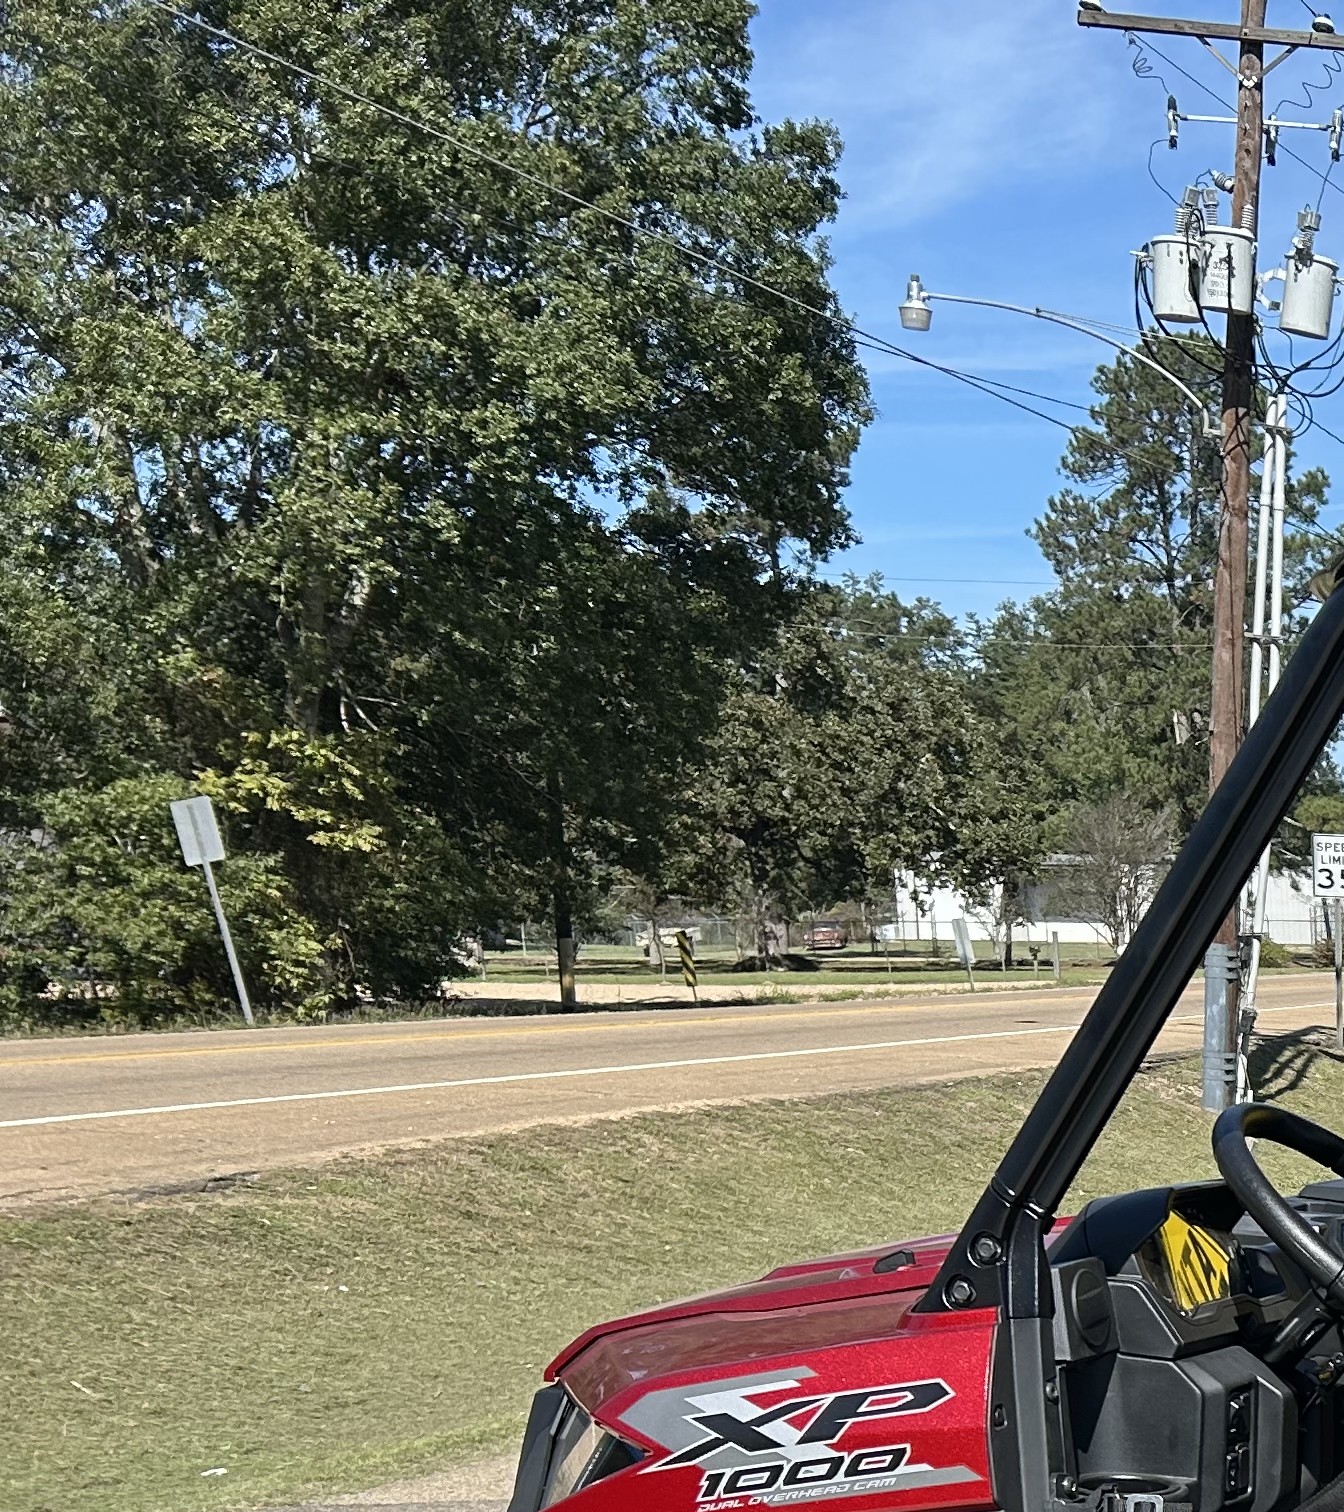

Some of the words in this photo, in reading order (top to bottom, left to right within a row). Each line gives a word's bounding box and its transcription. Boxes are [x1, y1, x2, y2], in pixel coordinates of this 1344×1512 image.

[639, 1377, 957, 1474] XP
[696, 1499, 745, 1512] DUAL
[748, 1483, 850, 1506] OVERHEAD
[853, 1477, 896, 1492] CAM
[697, 1443, 911, 1502] 1000
